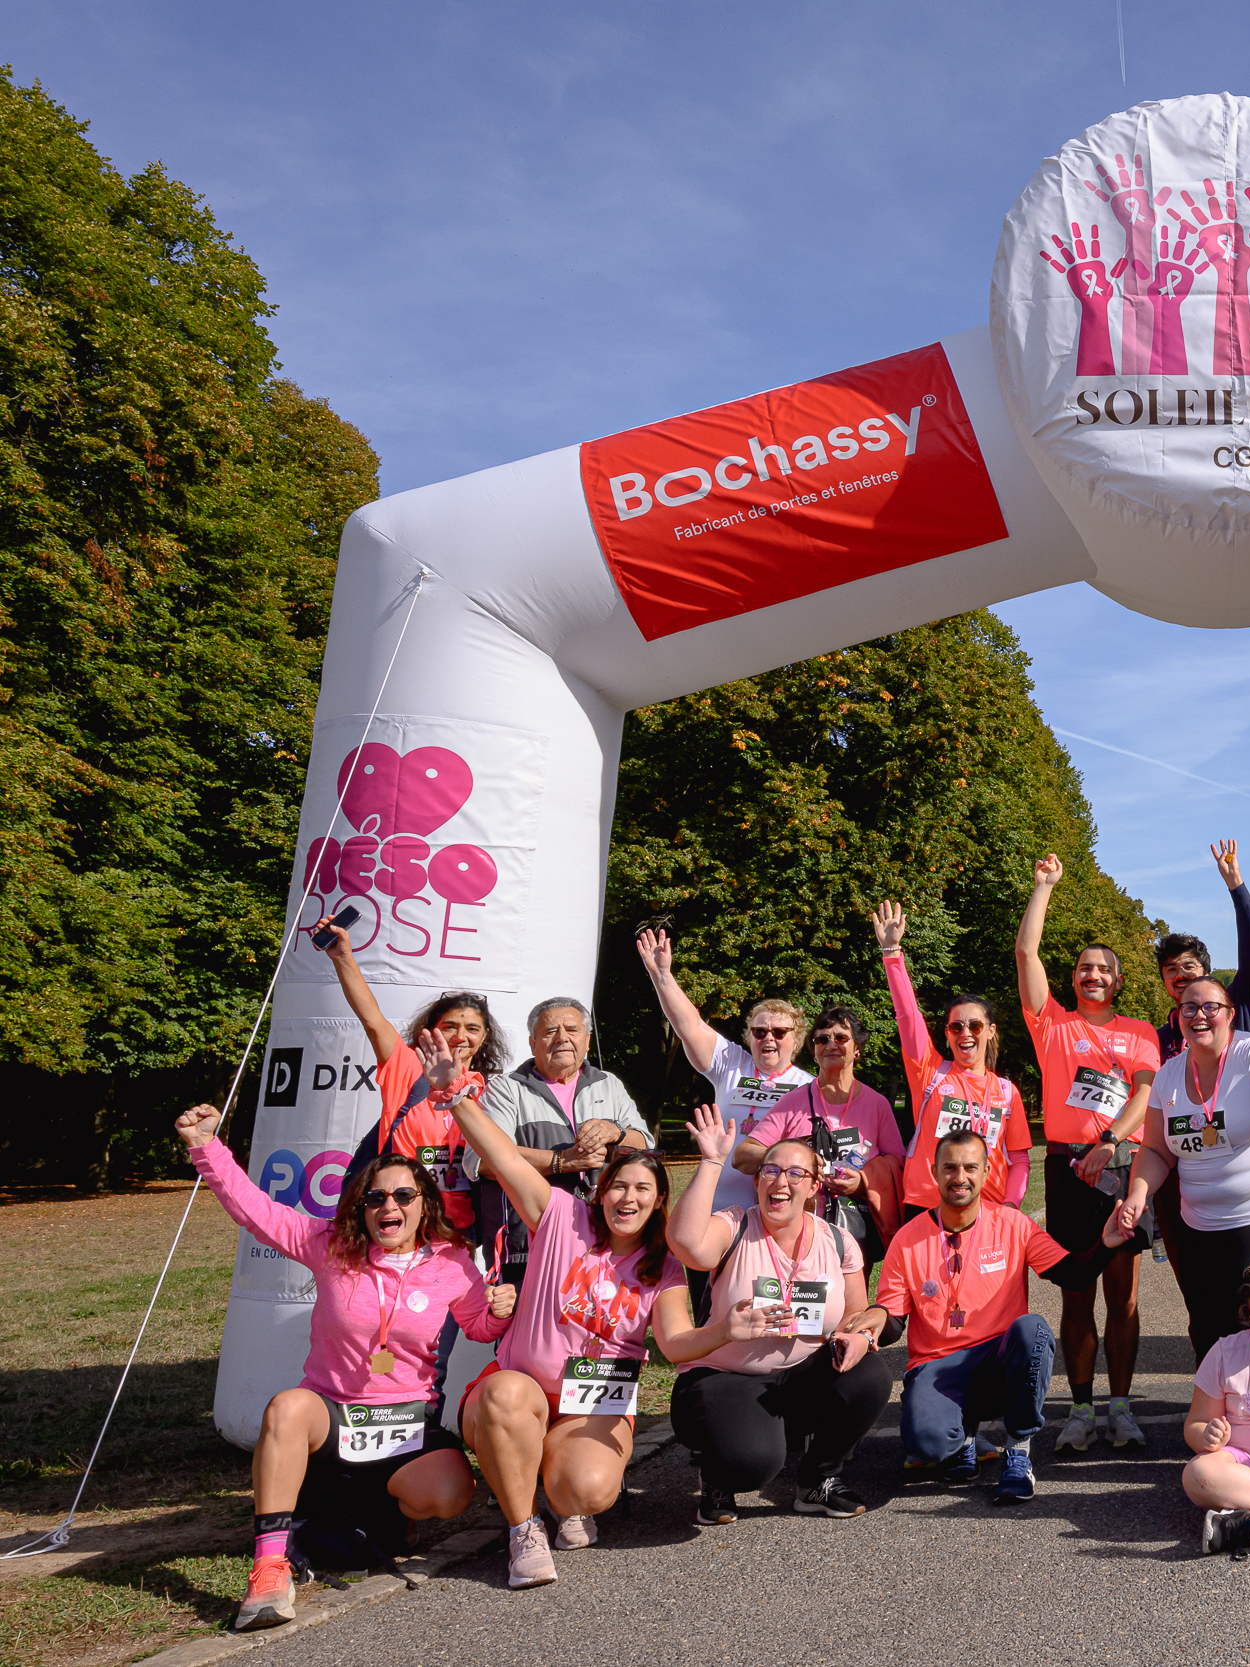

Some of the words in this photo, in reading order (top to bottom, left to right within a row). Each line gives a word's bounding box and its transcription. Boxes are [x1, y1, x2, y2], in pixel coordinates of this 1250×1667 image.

[1076, 389, 1245, 426] SOLEIL
[674, 509, 745, 541] Fabricant
[747, 503, 768, 521] de
[771, 490, 818, 516] portes
[821, 485, 837, 501] et
[838, 468, 899, 496] fenêtres
[251, 1247, 261, 1258] EN
[264, 1248, 290, 1259] COM
[766, 1285, 779, 1293] TDR
[577, 1365, 593, 1373] TDR
[604, 1370, 632, 1378] RUNNING
[578, 1384, 624, 1404] 724
[349, 1412, 366, 1420] TDR
[370, 1408, 393, 1416] TERRE
[379, 1413, 415, 1422] RUNNING
[350, 1429, 407, 1451] 815
